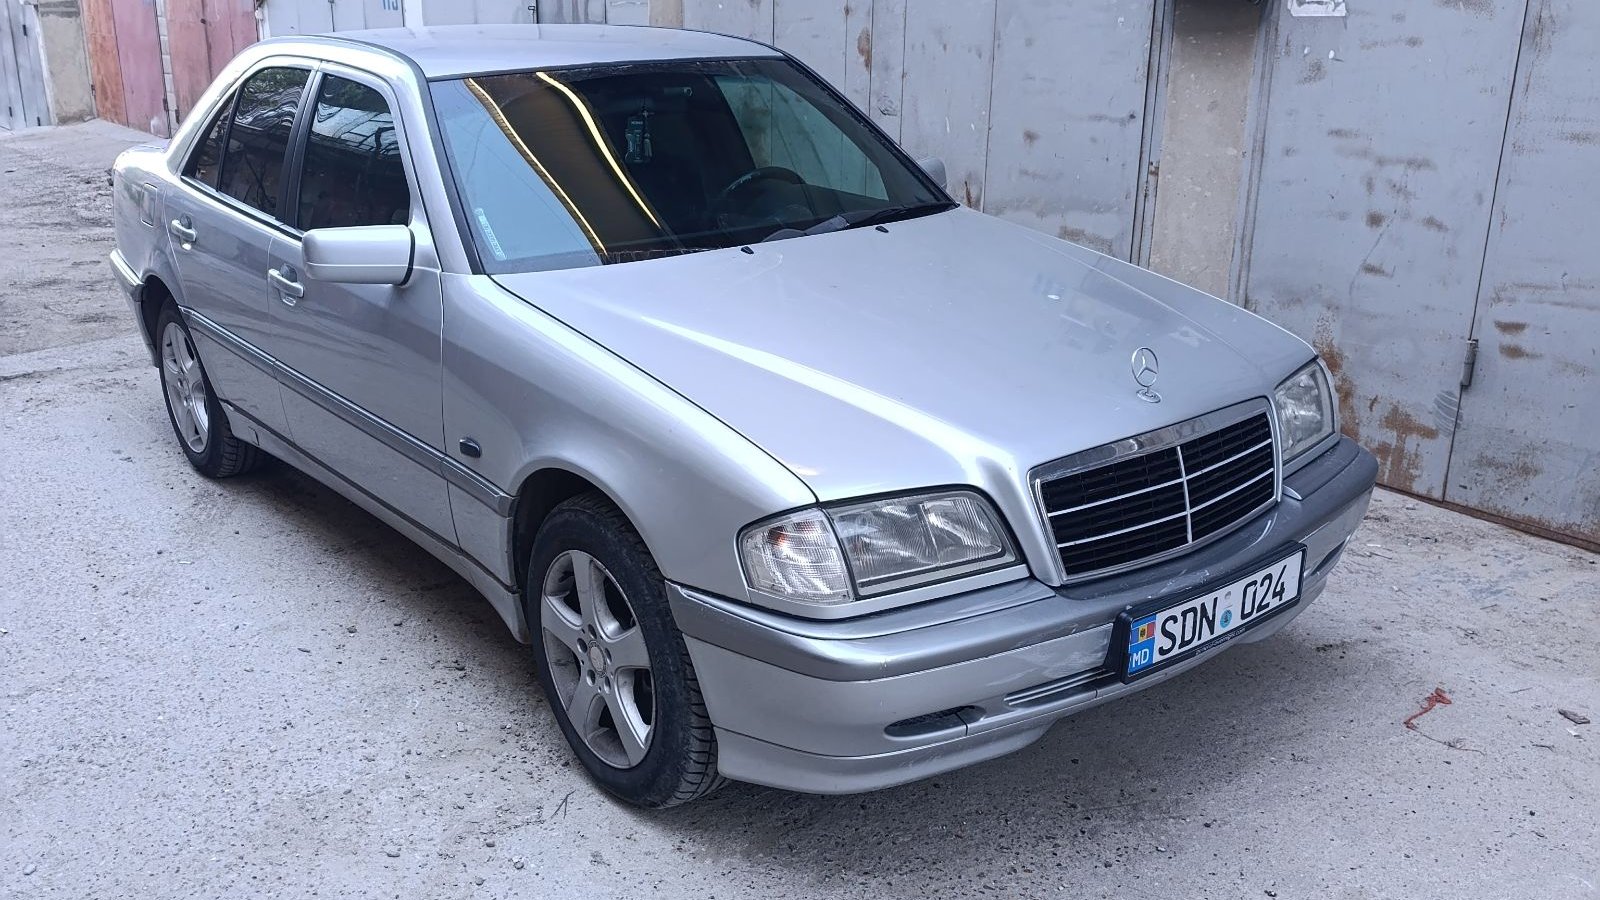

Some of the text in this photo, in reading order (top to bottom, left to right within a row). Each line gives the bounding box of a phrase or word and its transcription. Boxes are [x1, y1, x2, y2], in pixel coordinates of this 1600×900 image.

[1158, 597, 1218, 656] SDN
[1240, 565, 1287, 620] 024
[1132, 648, 1150, 668] MD
